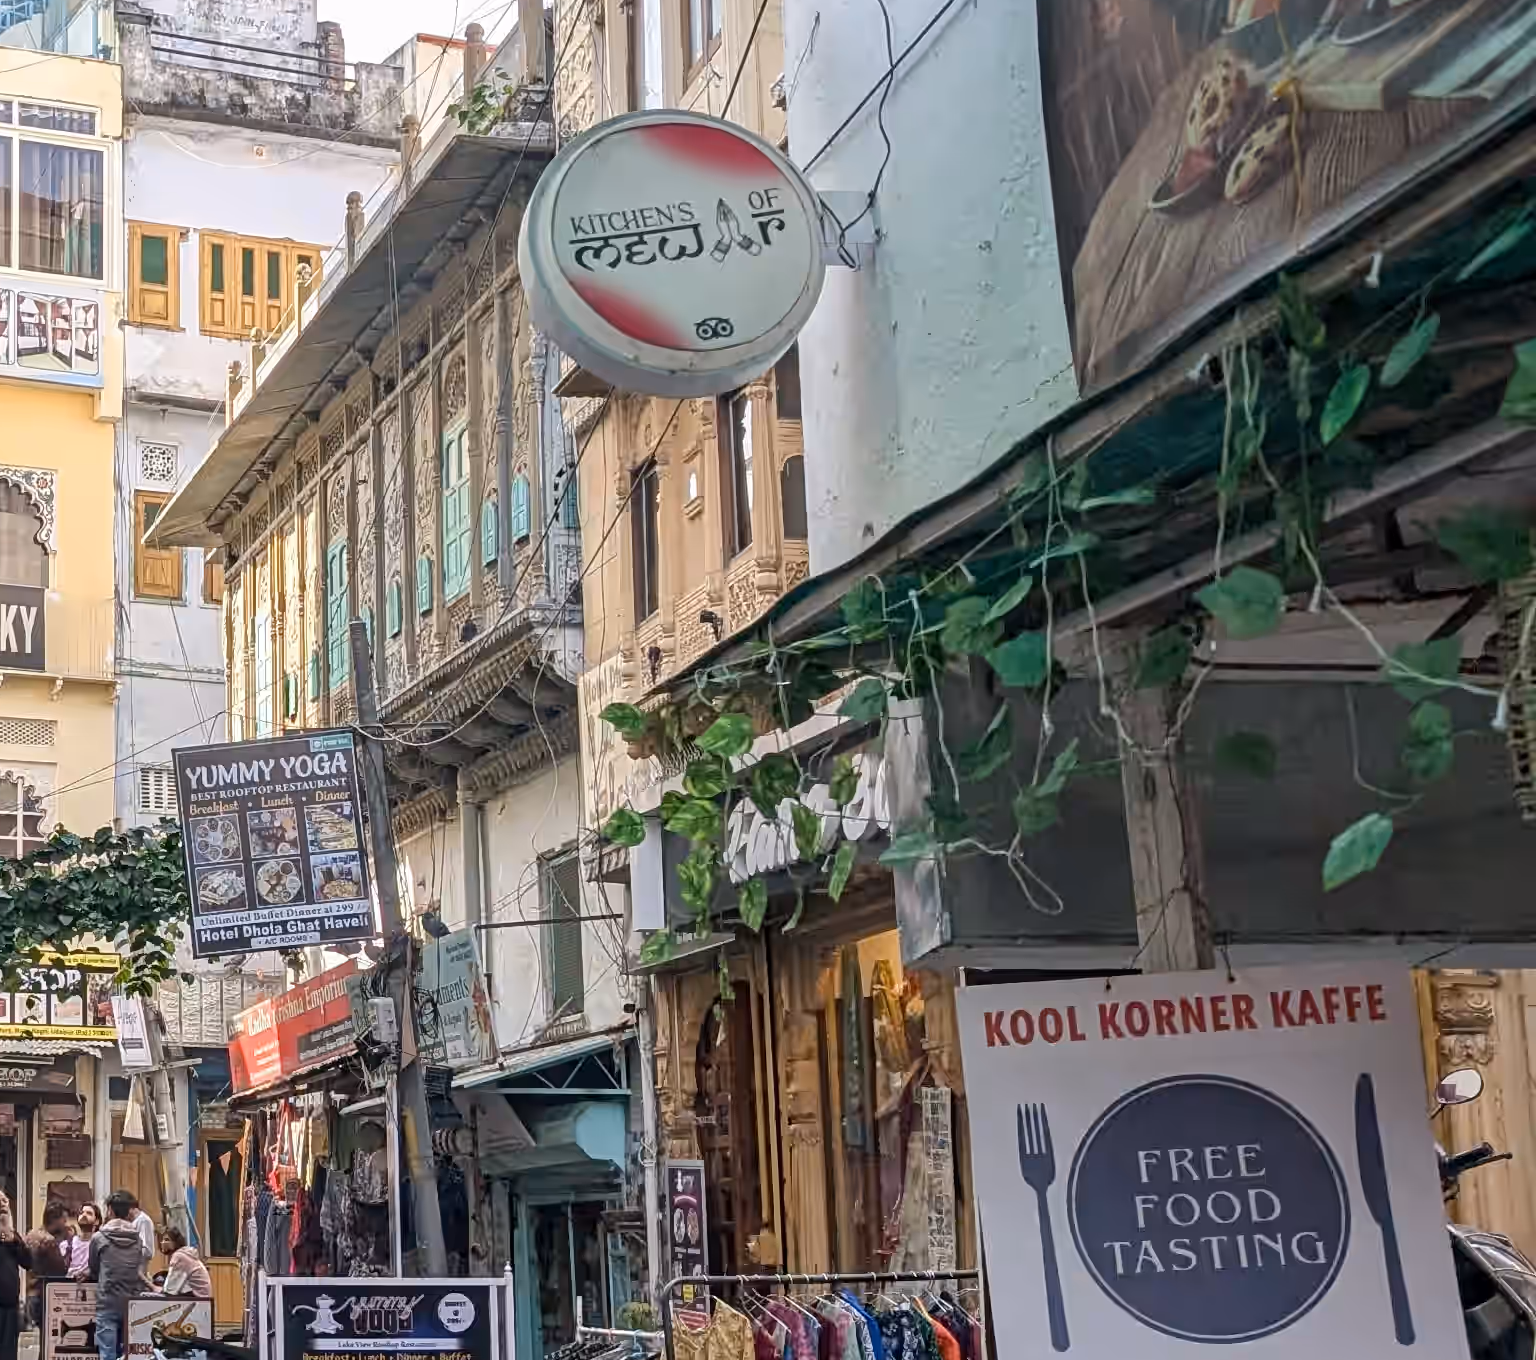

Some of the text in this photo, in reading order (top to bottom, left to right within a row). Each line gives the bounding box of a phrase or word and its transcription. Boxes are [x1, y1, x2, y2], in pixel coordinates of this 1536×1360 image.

[748, 188, 780, 210] OF
[186, 751, 348, 789] YUMMY YOGA
[190, 790, 350, 817] Breakfast Lunch Dinner
[191, 777, 347, 802] BEST ROOFTOP RESTAURANT
[201, 912, 251, 927] Unlimited
[286, 907, 321, 917] Dinner
[336, 904, 354, 912] 299
[201, 916, 369, 943] Hotel Dhola Ghat Haveli
[984, 983, 1388, 1049] KOOL KORNER KAFFE
[1137, 1142, 1266, 1183] FREE
[1135, 1187, 1282, 1230] FOOD
[1103, 1230, 1329, 1276] TASTING
